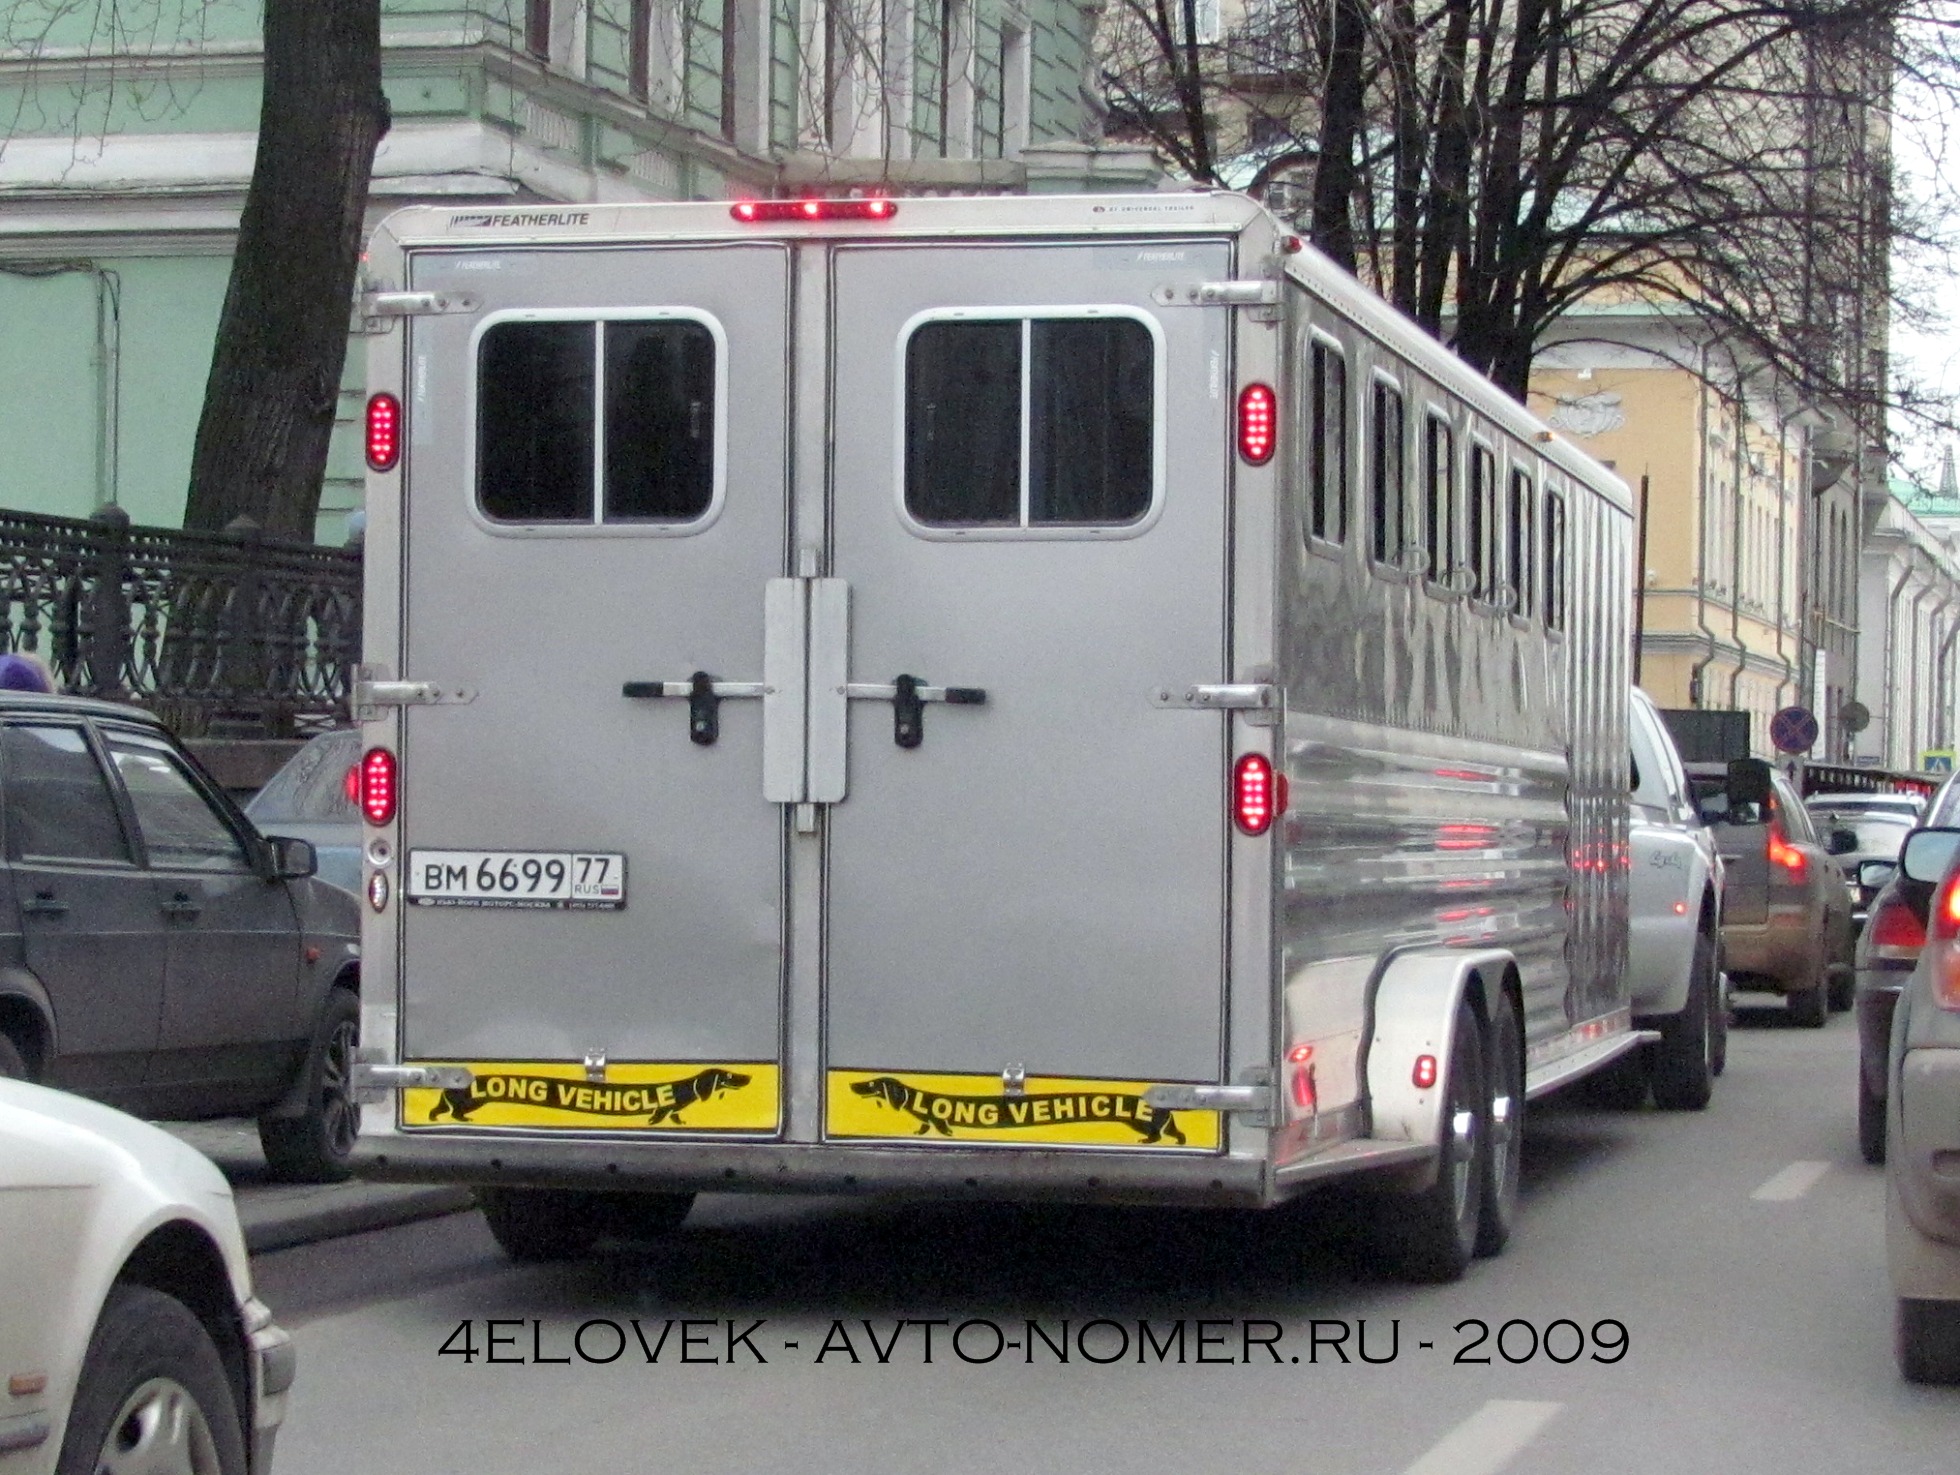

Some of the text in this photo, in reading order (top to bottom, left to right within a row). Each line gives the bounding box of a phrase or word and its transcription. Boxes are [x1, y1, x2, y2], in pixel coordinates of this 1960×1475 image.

[492, 213, 590, 227] FEATHERLITE
[577, 856, 611, 883] 77
[575, 884, 599, 895] RUS
[470, 1076, 677, 1112] LONG VEHICLE
[912, 1090, 1154, 1126] LONG VEHICLE
